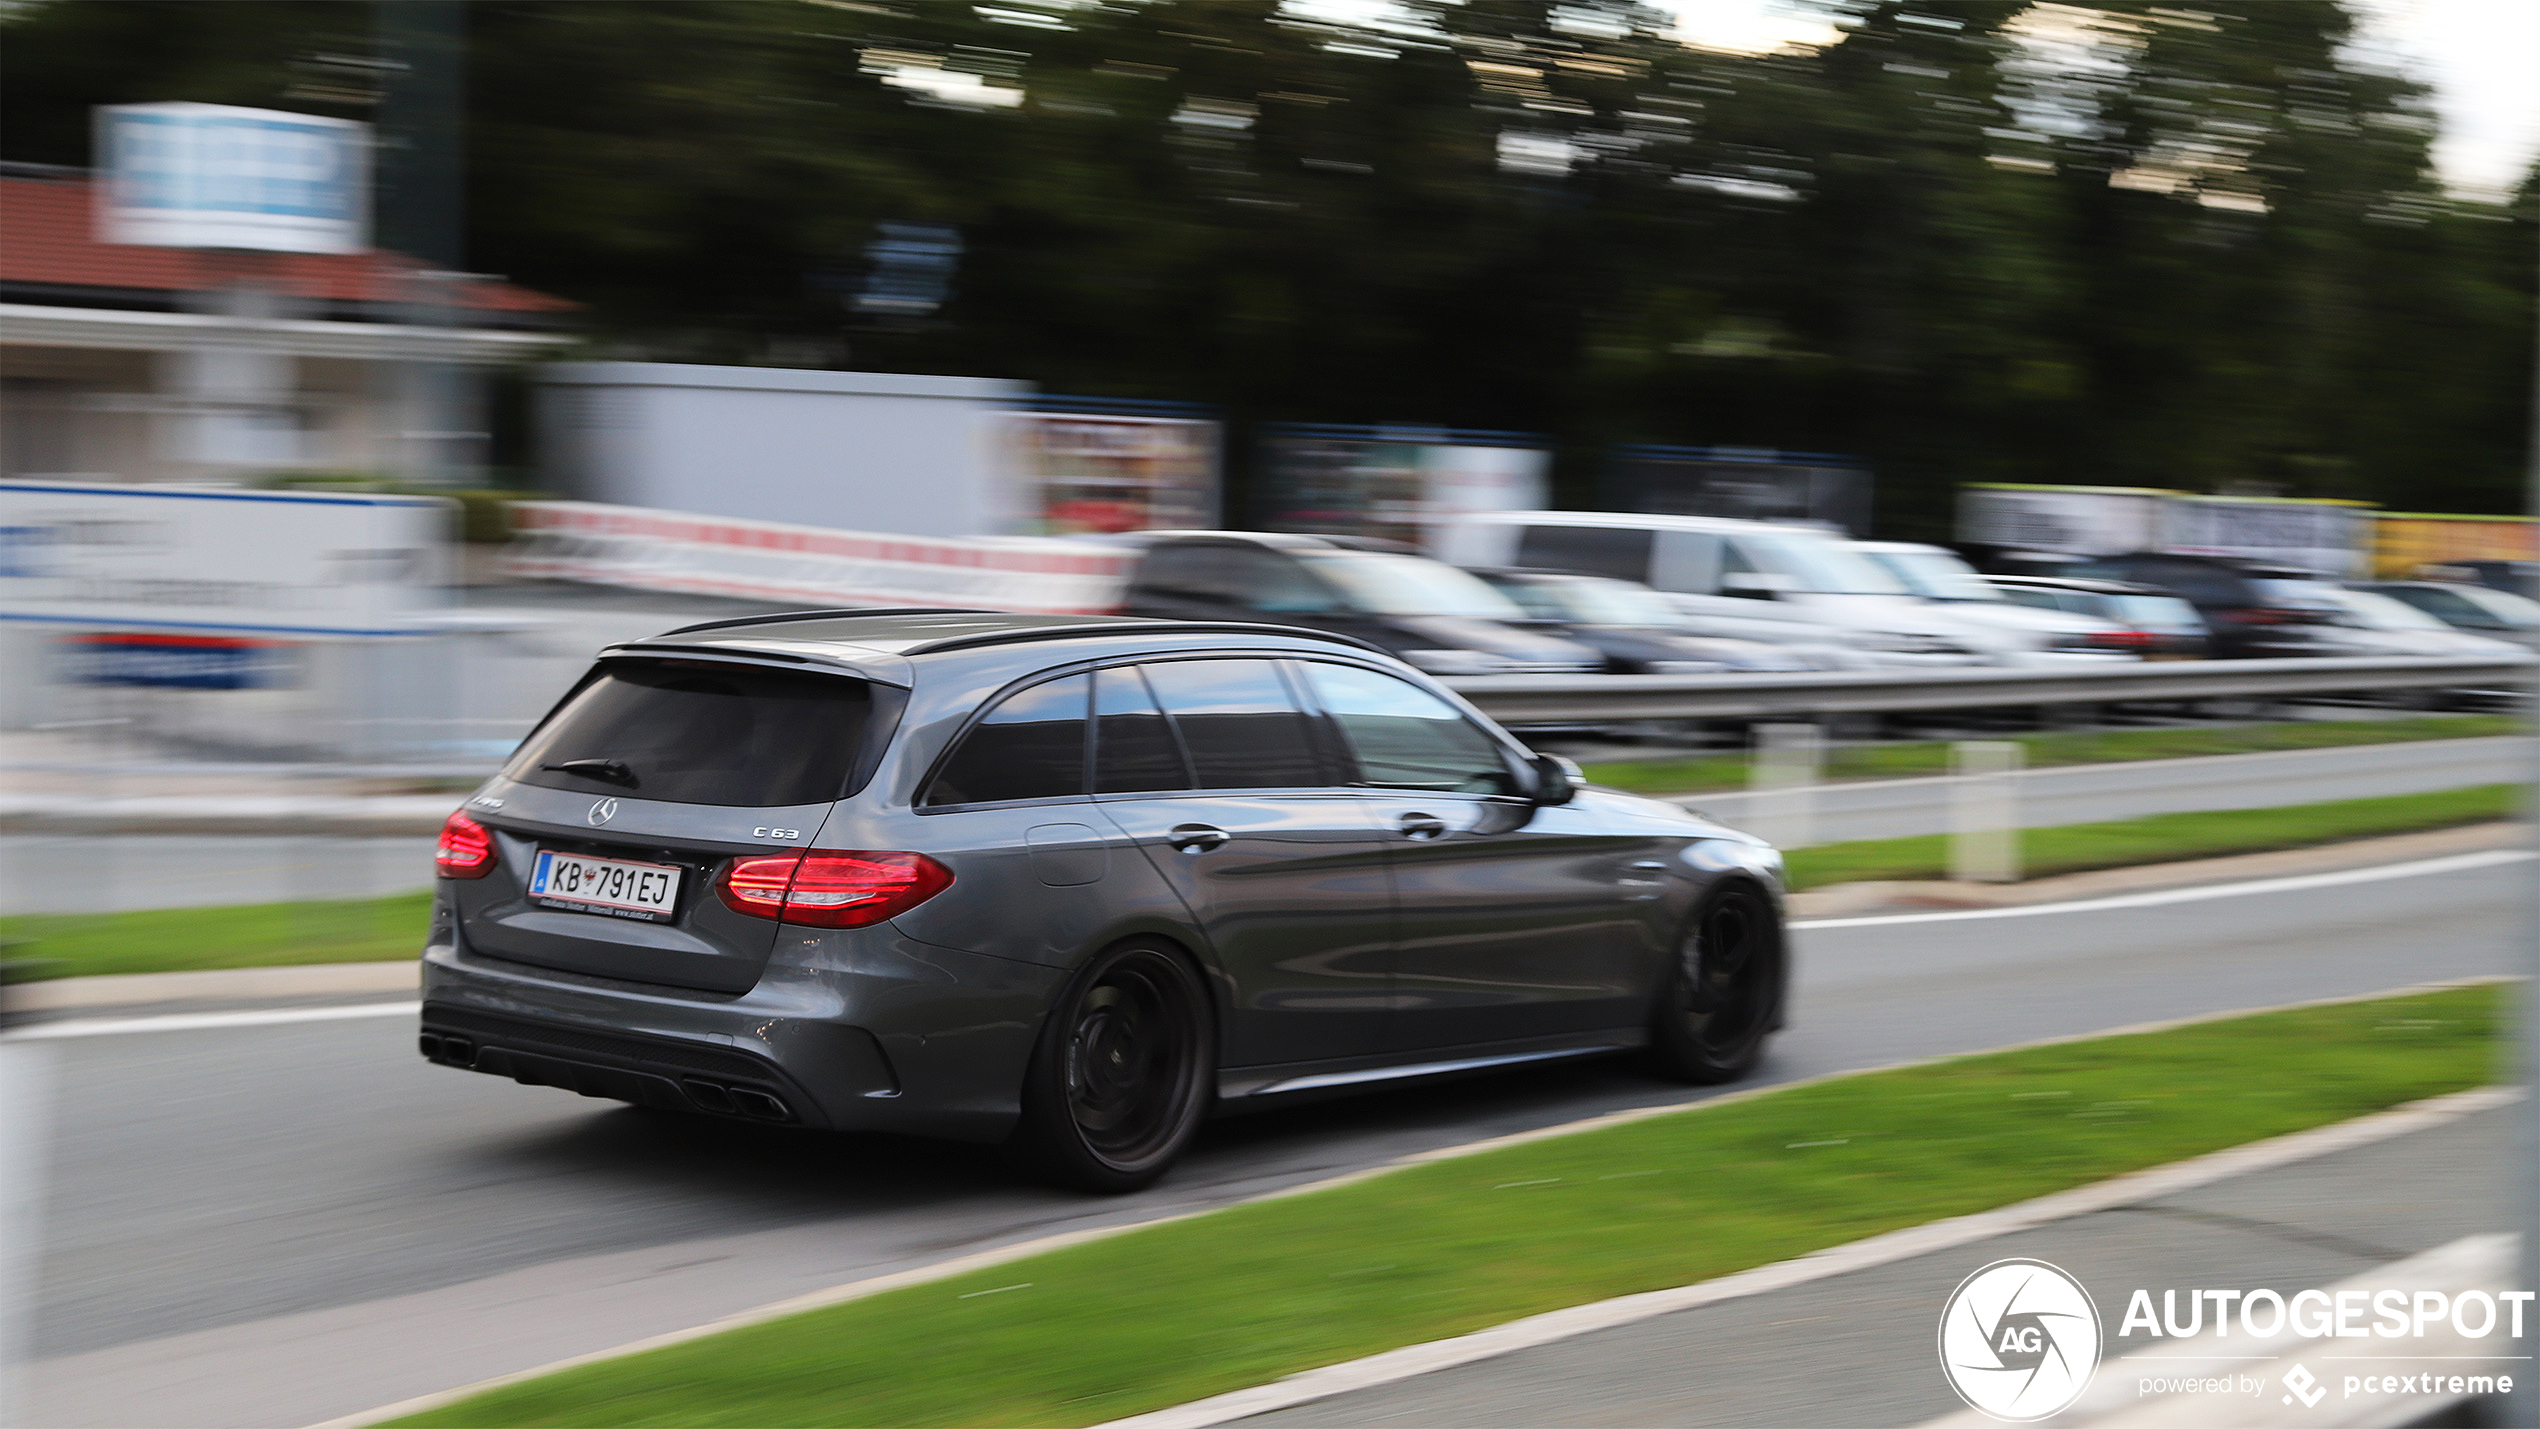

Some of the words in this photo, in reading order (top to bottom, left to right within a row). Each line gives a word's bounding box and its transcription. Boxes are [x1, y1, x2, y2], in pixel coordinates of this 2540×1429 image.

[753, 826, 767, 838] C
[771, 828, 800, 840] 63
[552, 860, 582, 892] KB
